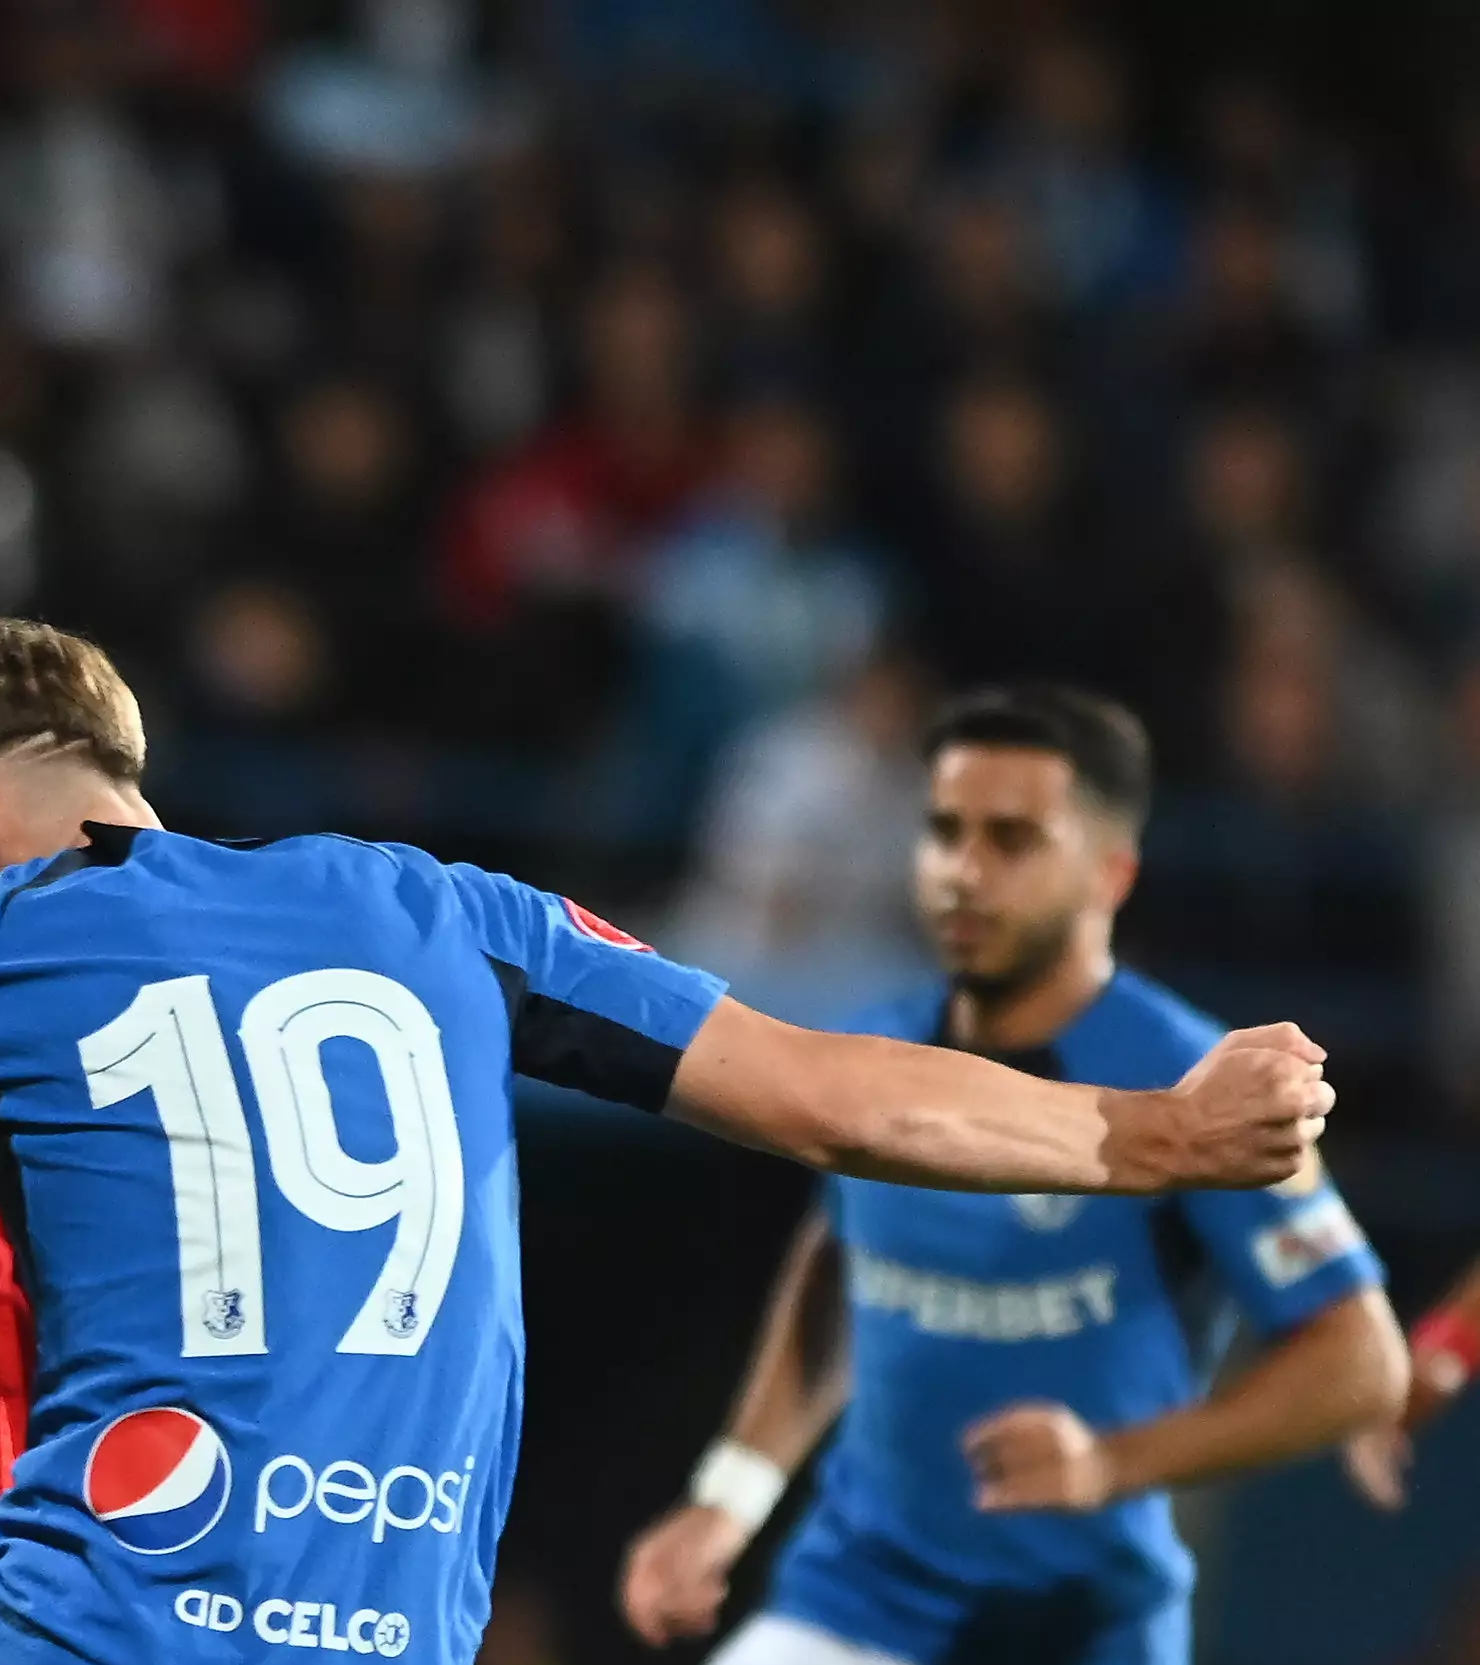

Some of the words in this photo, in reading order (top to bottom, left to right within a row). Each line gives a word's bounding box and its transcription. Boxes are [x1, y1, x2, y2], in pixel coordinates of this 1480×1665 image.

[77, 967, 464, 1357] 19
[254, 1454, 476, 1543] pepsi
[253, 1598, 410, 1658] CELCO
